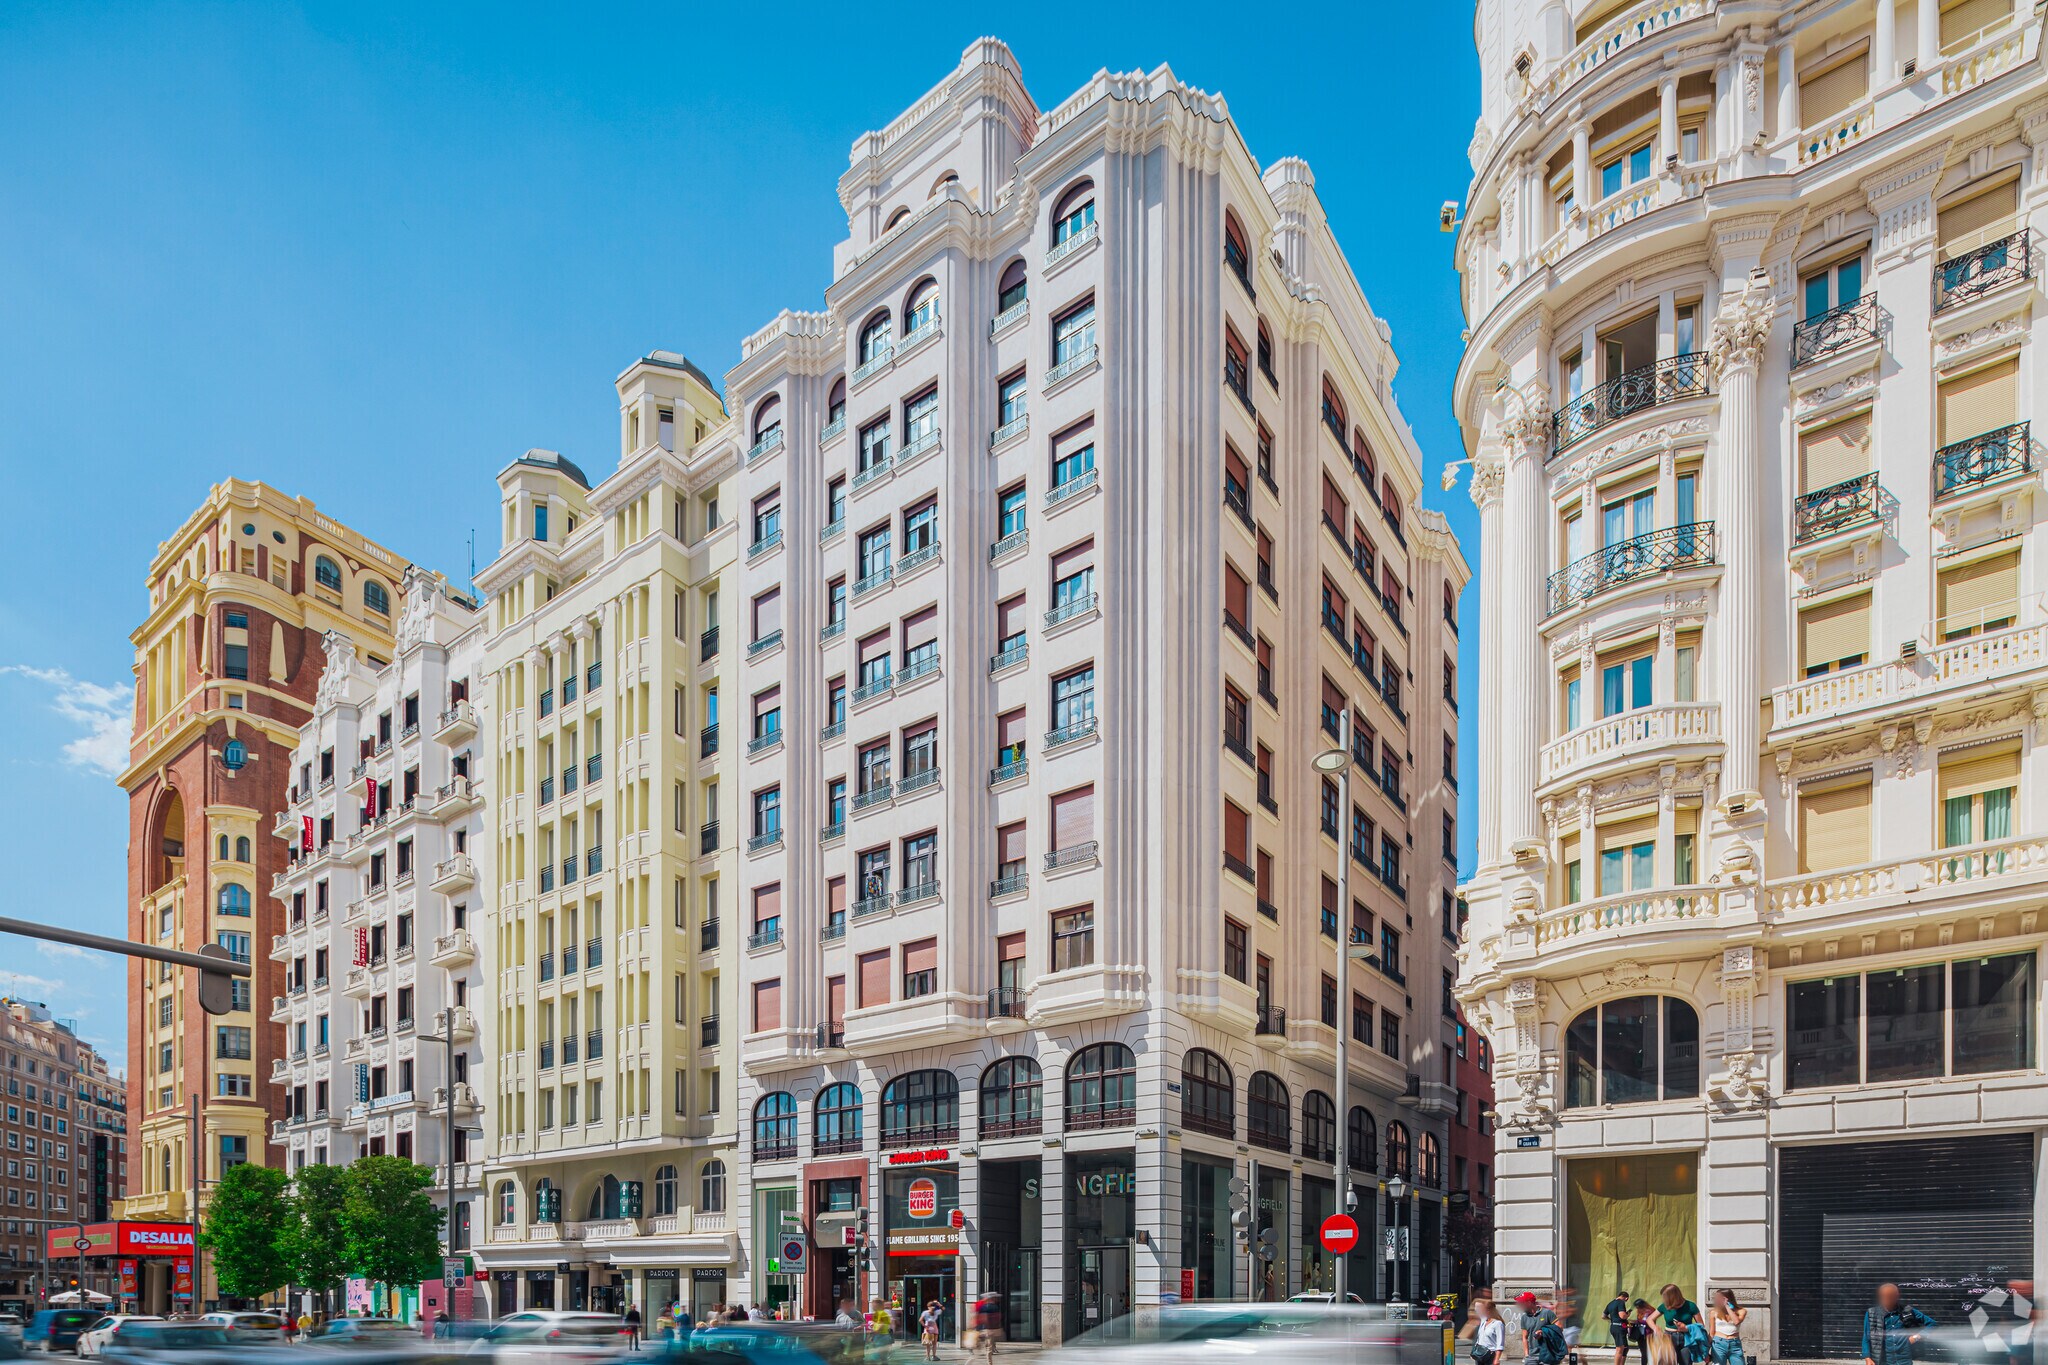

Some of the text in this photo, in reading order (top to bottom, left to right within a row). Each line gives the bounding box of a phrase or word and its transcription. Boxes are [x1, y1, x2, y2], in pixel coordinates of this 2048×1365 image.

[924, 1149, 949, 1161] KING
[97, 1150, 105, 1206] HOTEL
[909, 1191, 934, 1199] BURGER
[909, 1199, 934, 1210] KING
[130, 1231, 194, 1245] DESALIA
[886, 1234, 959, 1245] FLAME GRILLING SINCE 195
